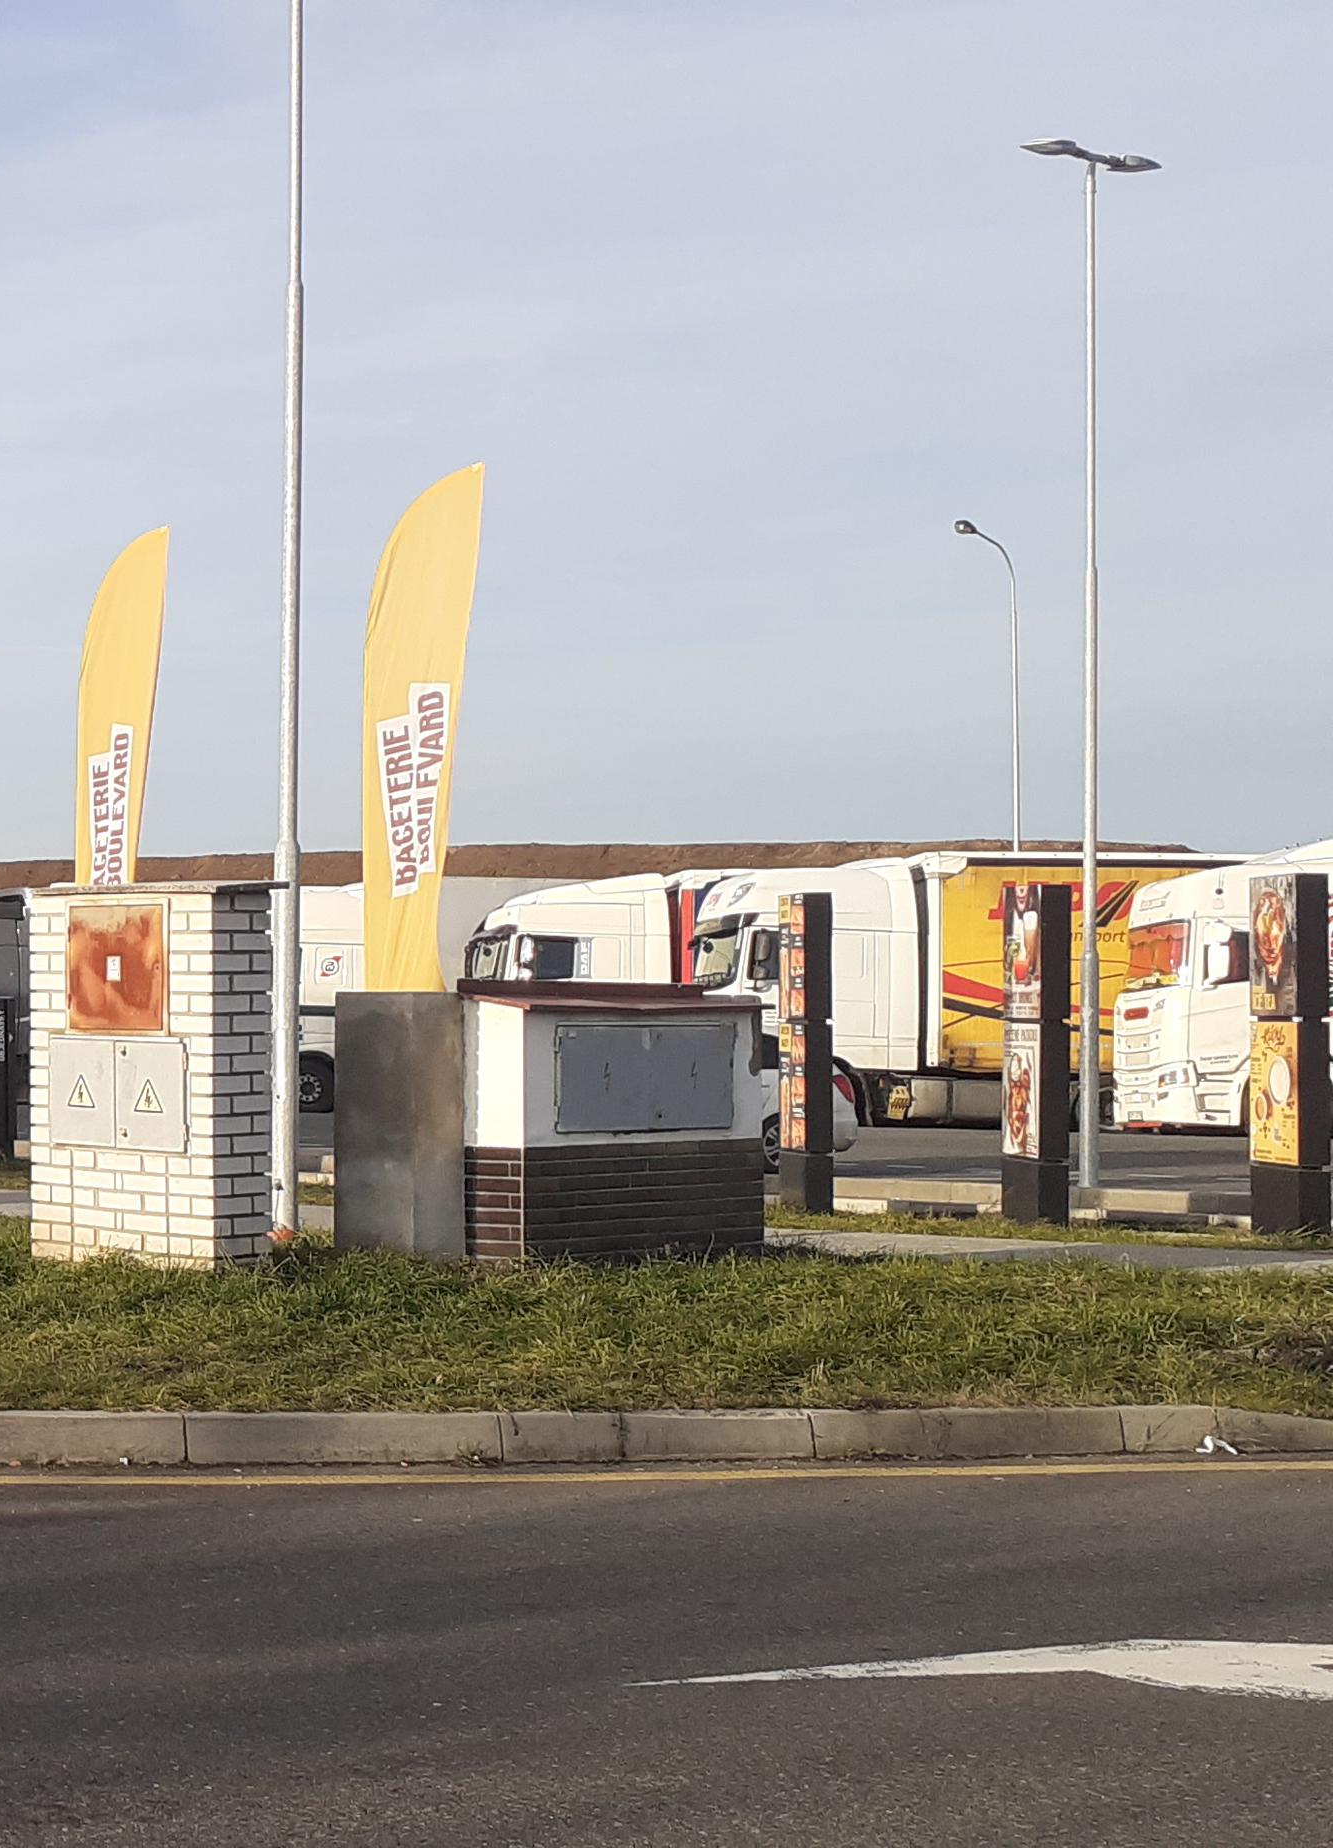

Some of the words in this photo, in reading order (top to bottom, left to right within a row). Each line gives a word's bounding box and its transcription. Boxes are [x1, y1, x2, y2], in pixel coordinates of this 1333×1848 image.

[93, 761, 110, 885] AGETERIE
[107, 732, 129, 885] BOULEVARD
[580, 942, 589, 975] DAF
